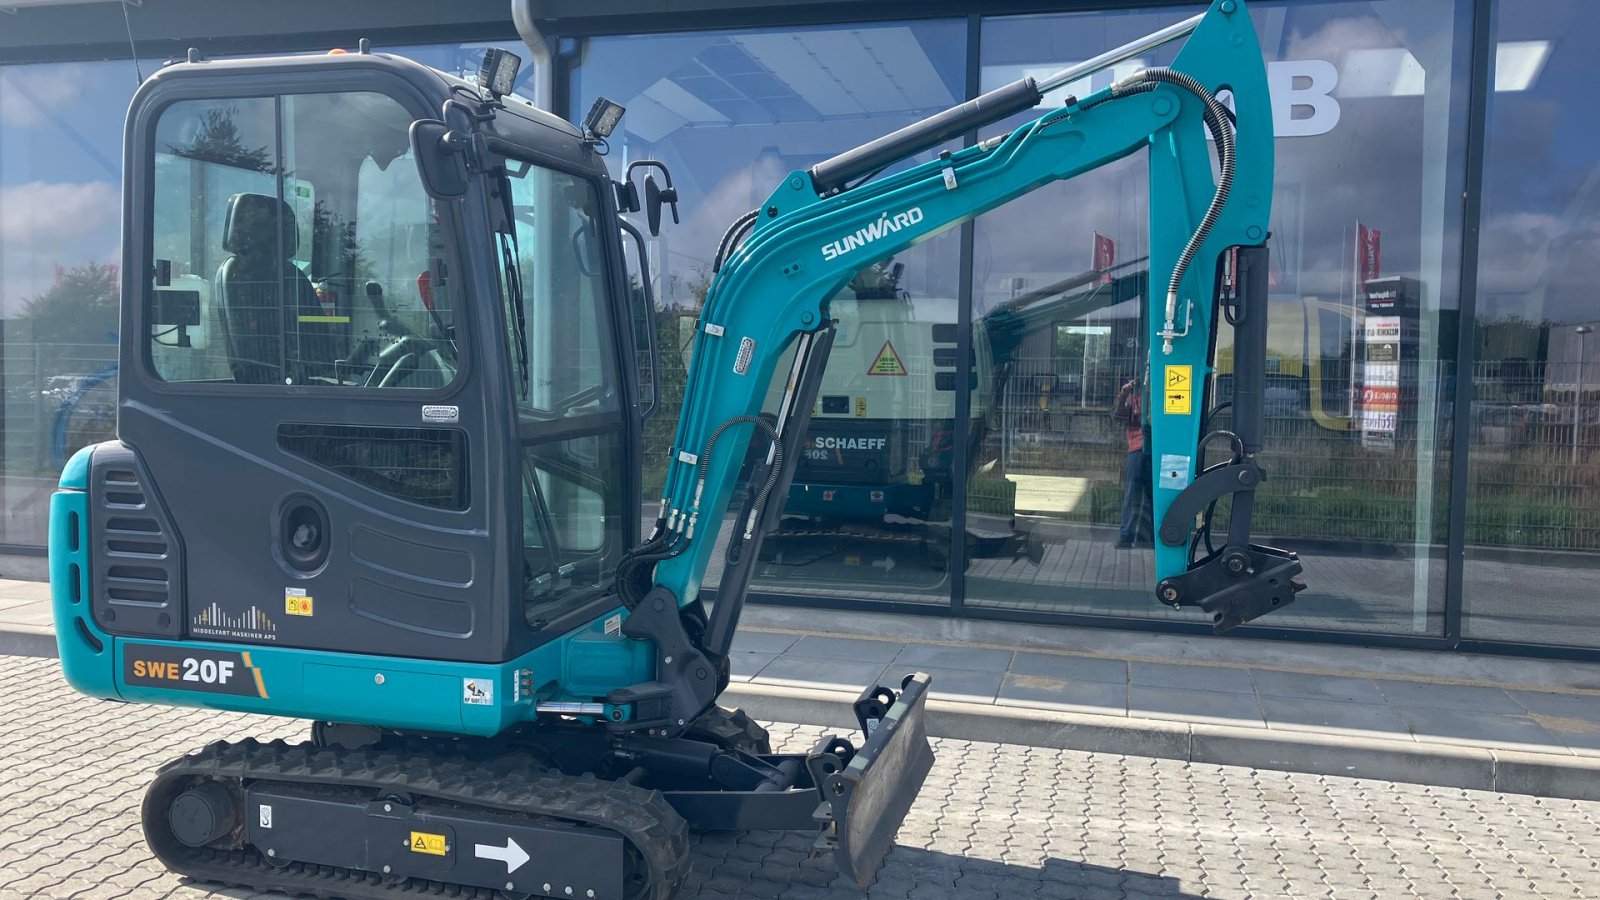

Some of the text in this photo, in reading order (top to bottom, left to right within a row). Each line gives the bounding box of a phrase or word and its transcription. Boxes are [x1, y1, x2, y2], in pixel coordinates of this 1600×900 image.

[821, 207, 924, 261] SUNWARD
[815, 437, 886, 450] SCHAEFF
[193, 627, 230, 637] MIDDELFART
[232, 631, 262, 639] MASKINER
